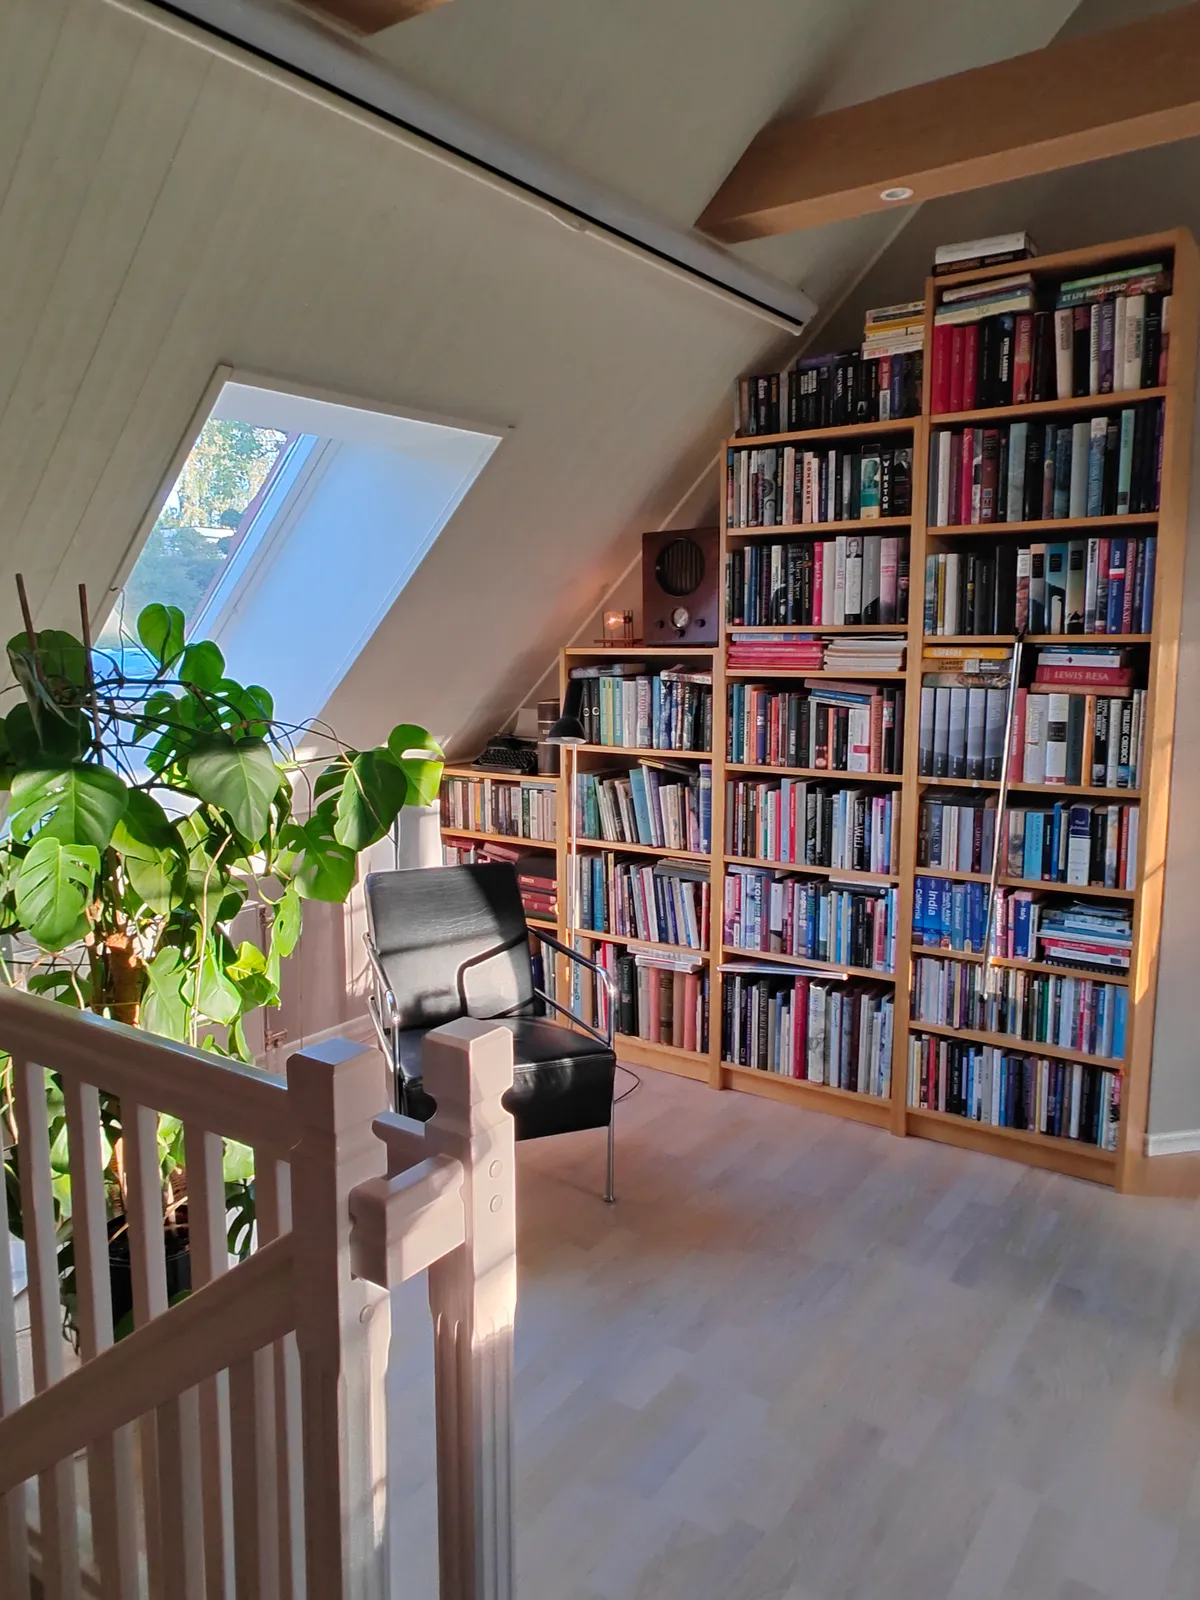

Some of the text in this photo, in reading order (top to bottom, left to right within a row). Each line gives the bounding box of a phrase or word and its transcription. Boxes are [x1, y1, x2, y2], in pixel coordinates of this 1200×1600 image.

[1001, 355, 1010, 382] LARSSON
[882, 460, 890, 509] WINSTON
[794, 560, 803, 599] Albert Speer
[1054, 670, 1110, 681] LEWIS RESA
[1120, 709, 1131, 764] BIBLISK ORDBOK
[932, 822, 941, 841] KARL
[914, 888, 923, 920] California
[927, 890, 939, 916] India
[996, 898, 1004, 937] Switzerland
[1018, 907, 1027, 921] Italy
[759, 988, 767, 1055] UTSIKT MOT EUROPA
